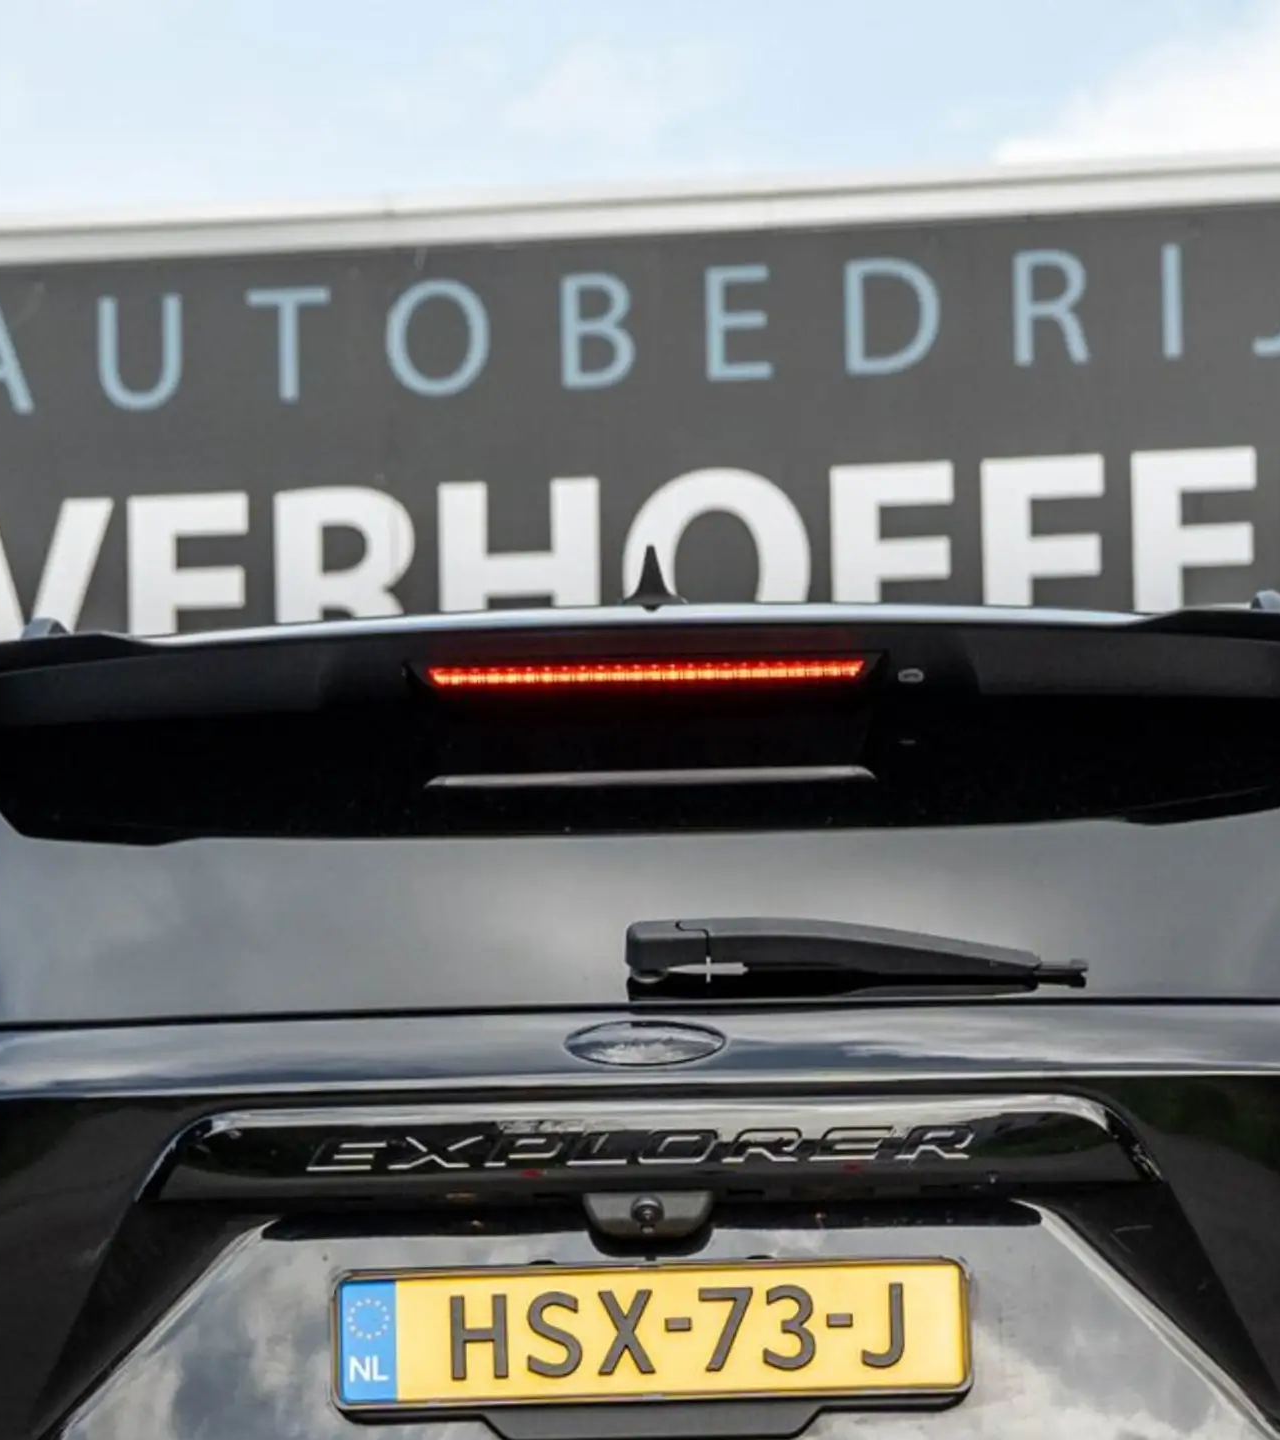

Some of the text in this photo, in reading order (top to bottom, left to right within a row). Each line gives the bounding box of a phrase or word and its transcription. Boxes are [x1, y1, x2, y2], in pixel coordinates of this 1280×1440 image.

[305, 1124, 977, 1173] EXPLORER
[450, 1282, 905, 1380] HSX-73-J
[348, 1355, 389, 1384] NL
